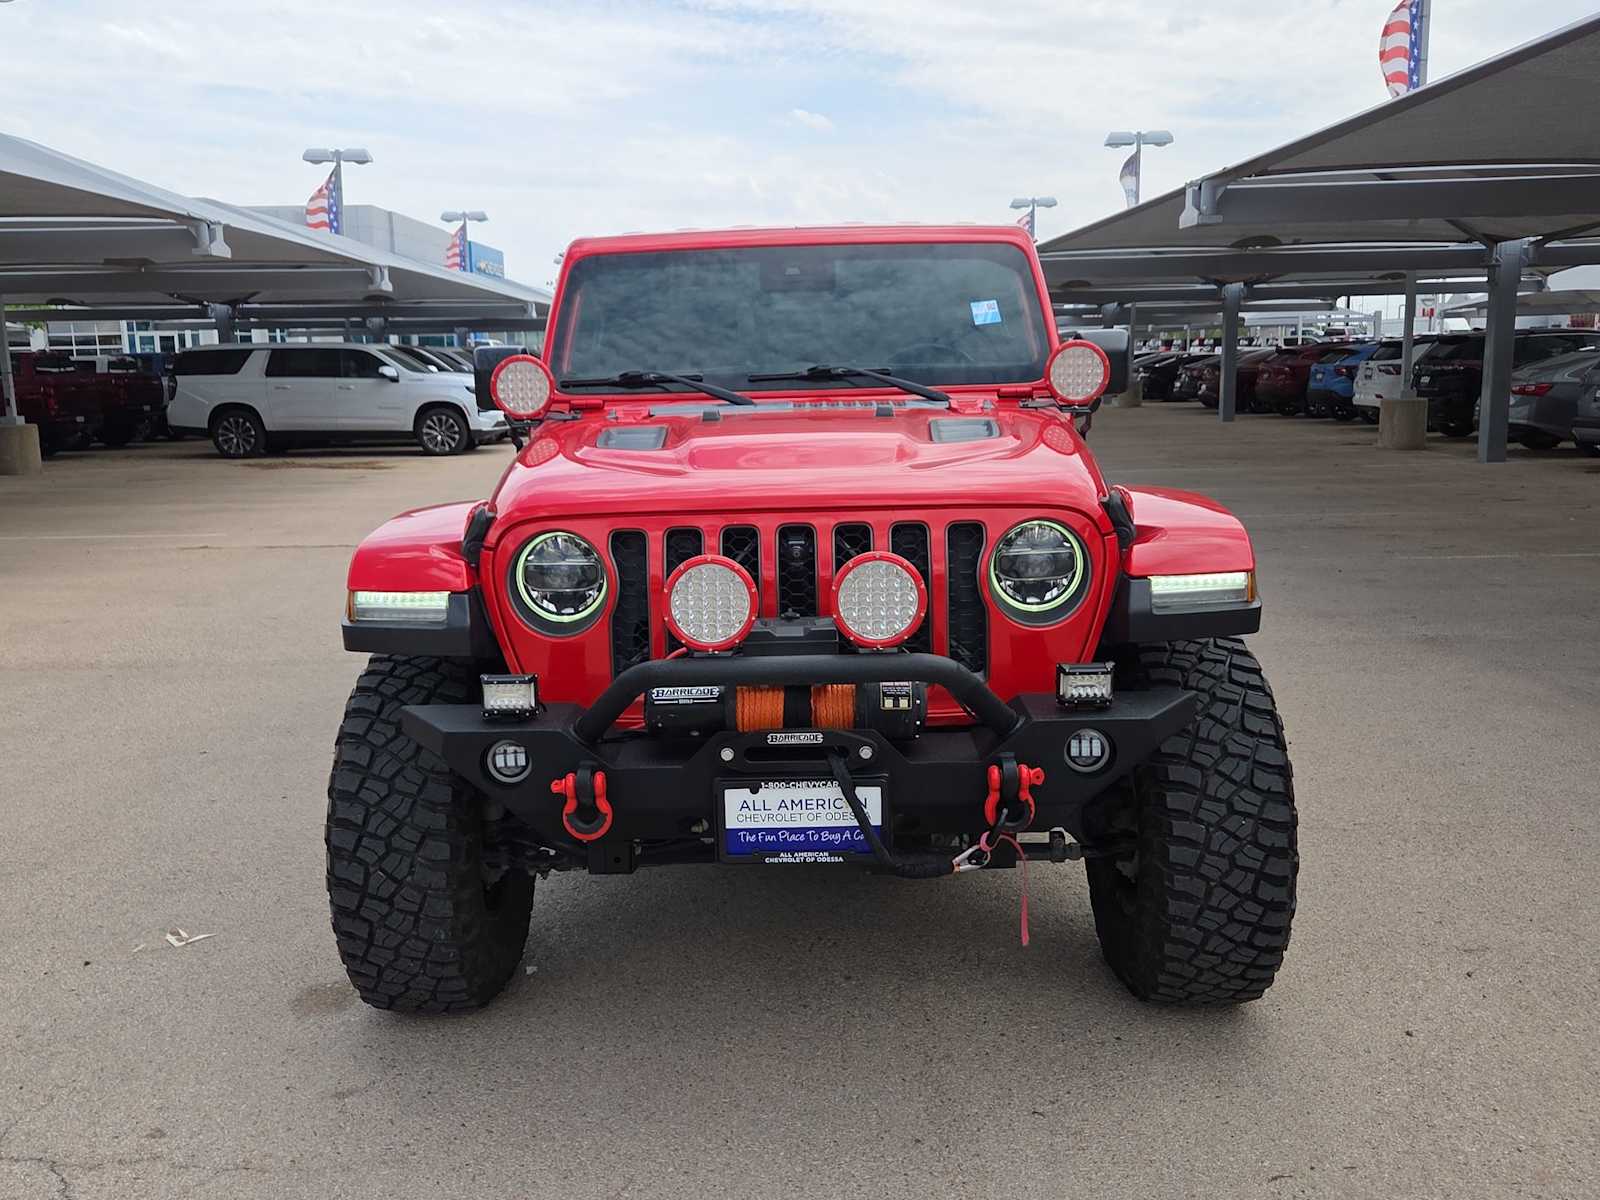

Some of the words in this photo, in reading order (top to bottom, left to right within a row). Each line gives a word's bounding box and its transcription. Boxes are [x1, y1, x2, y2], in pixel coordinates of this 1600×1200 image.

[654, 687, 719, 698] BARRICADE
[769, 734, 823, 743] BARRICADE
[740, 799, 772, 811] ALL
[778, 797, 867, 811] AMERICN
[737, 812, 804, 823] CHEVROLET
[807, 812, 822, 822] OF
[825, 811, 872, 821] ODES
[738, 831, 756, 842] The
[758, 831, 777, 842] Fun
[778, 830, 805, 842] Place
[806, 830, 819, 841] To
[820, 830, 841, 844] Buy
[843, 830, 851, 841] A
[854, 829, 865, 840] Ca
